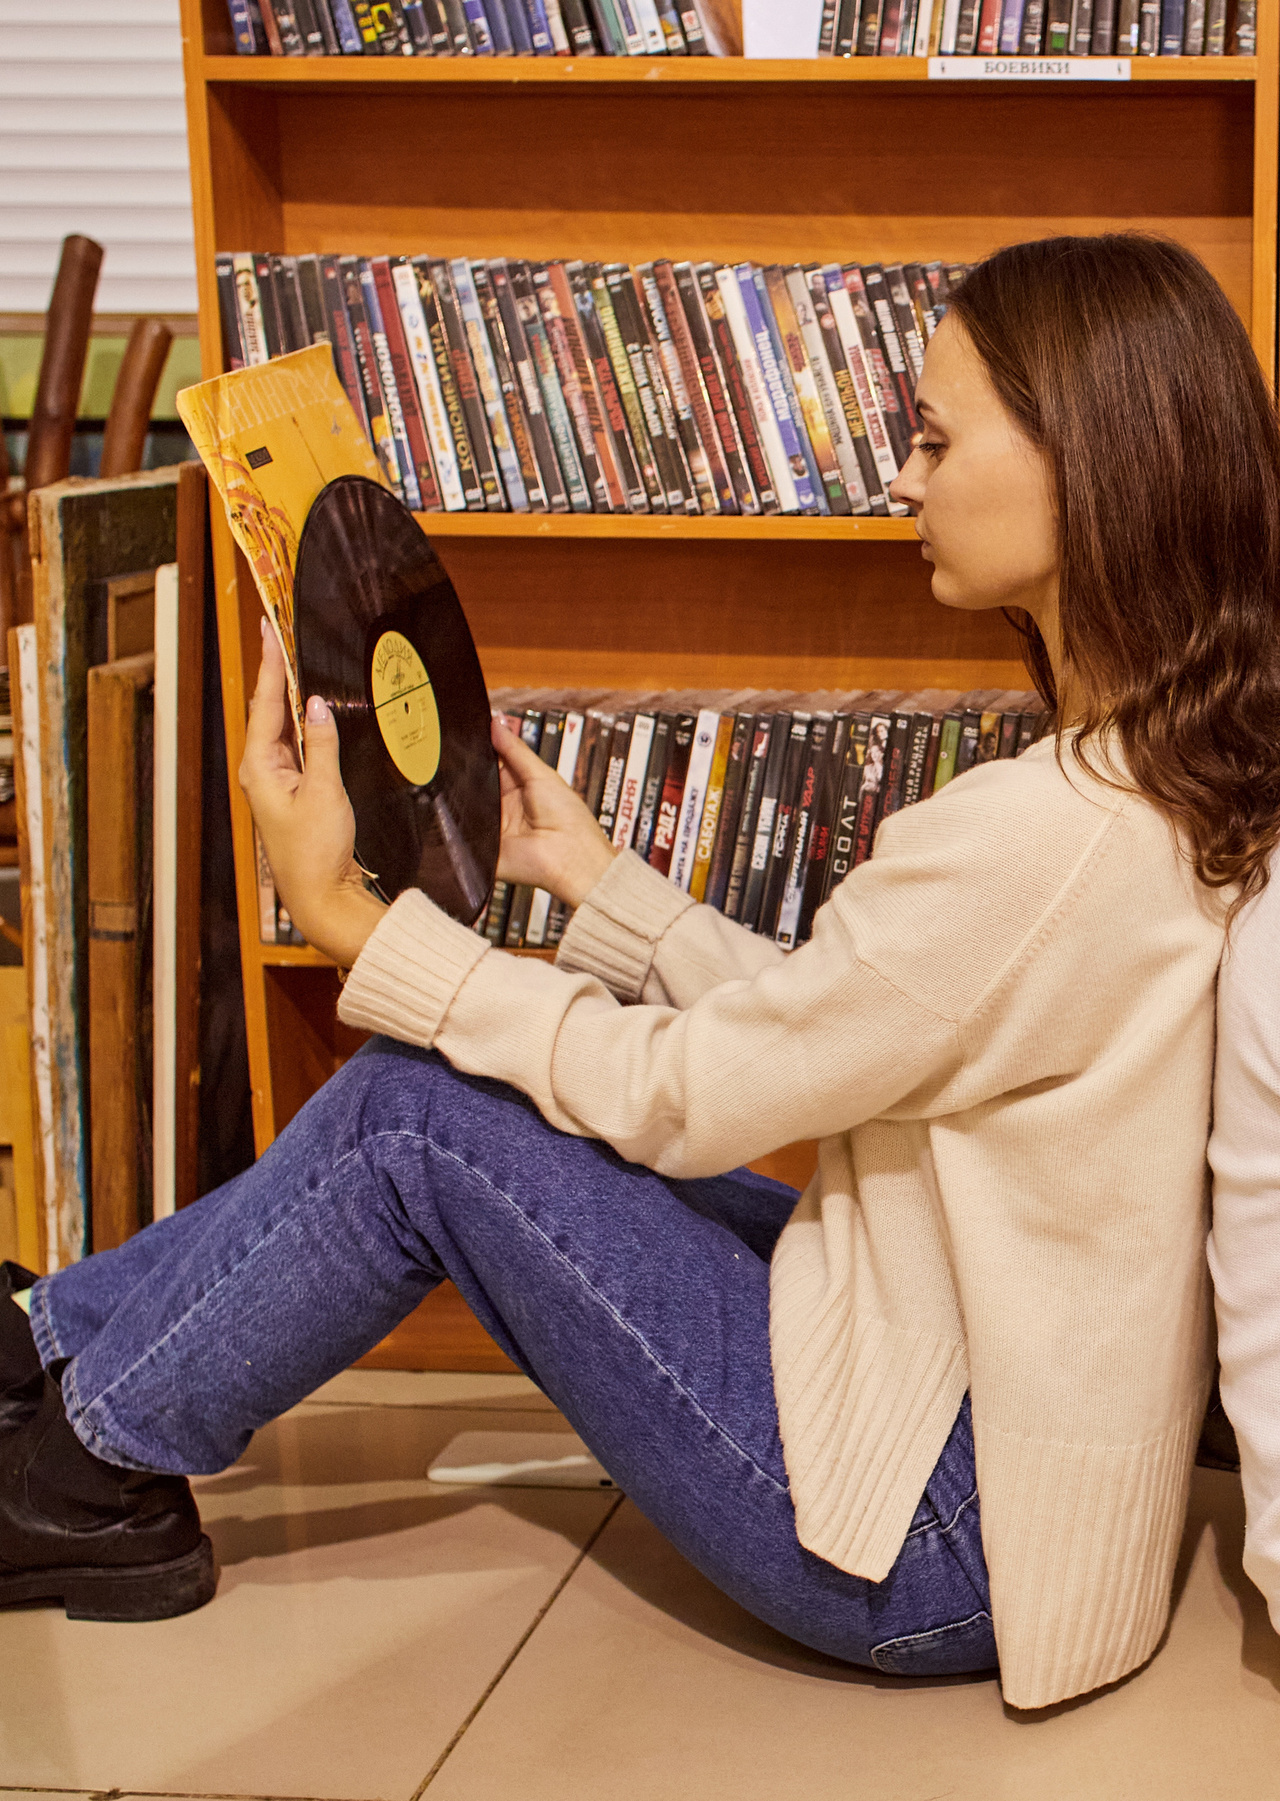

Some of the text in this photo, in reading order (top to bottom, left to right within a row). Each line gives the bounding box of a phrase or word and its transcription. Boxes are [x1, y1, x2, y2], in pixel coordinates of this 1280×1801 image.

[984, 61, 1070, 74] БОЕВИКИ
[641, 276, 672, 340] МОМЕНТ
[427, 321, 473, 470] КОЛОМБИАНА
[833, 369, 866, 437] МЕДАЛЬОН
[375, 638, 413, 678] МЕЛОДИЯ
[600, 756, 625, 813] ЗАКОНЕ
[619, 778, 638, 819] ДНЯ
[680, 786, 699, 837] ПРОДАЖУ
[678, 840, 689, 853] НА
[696, 787, 722, 859] САБОТАЖ
[784, 766, 817, 902] СМЕРТЕЛЬНЫЙ УДАР
